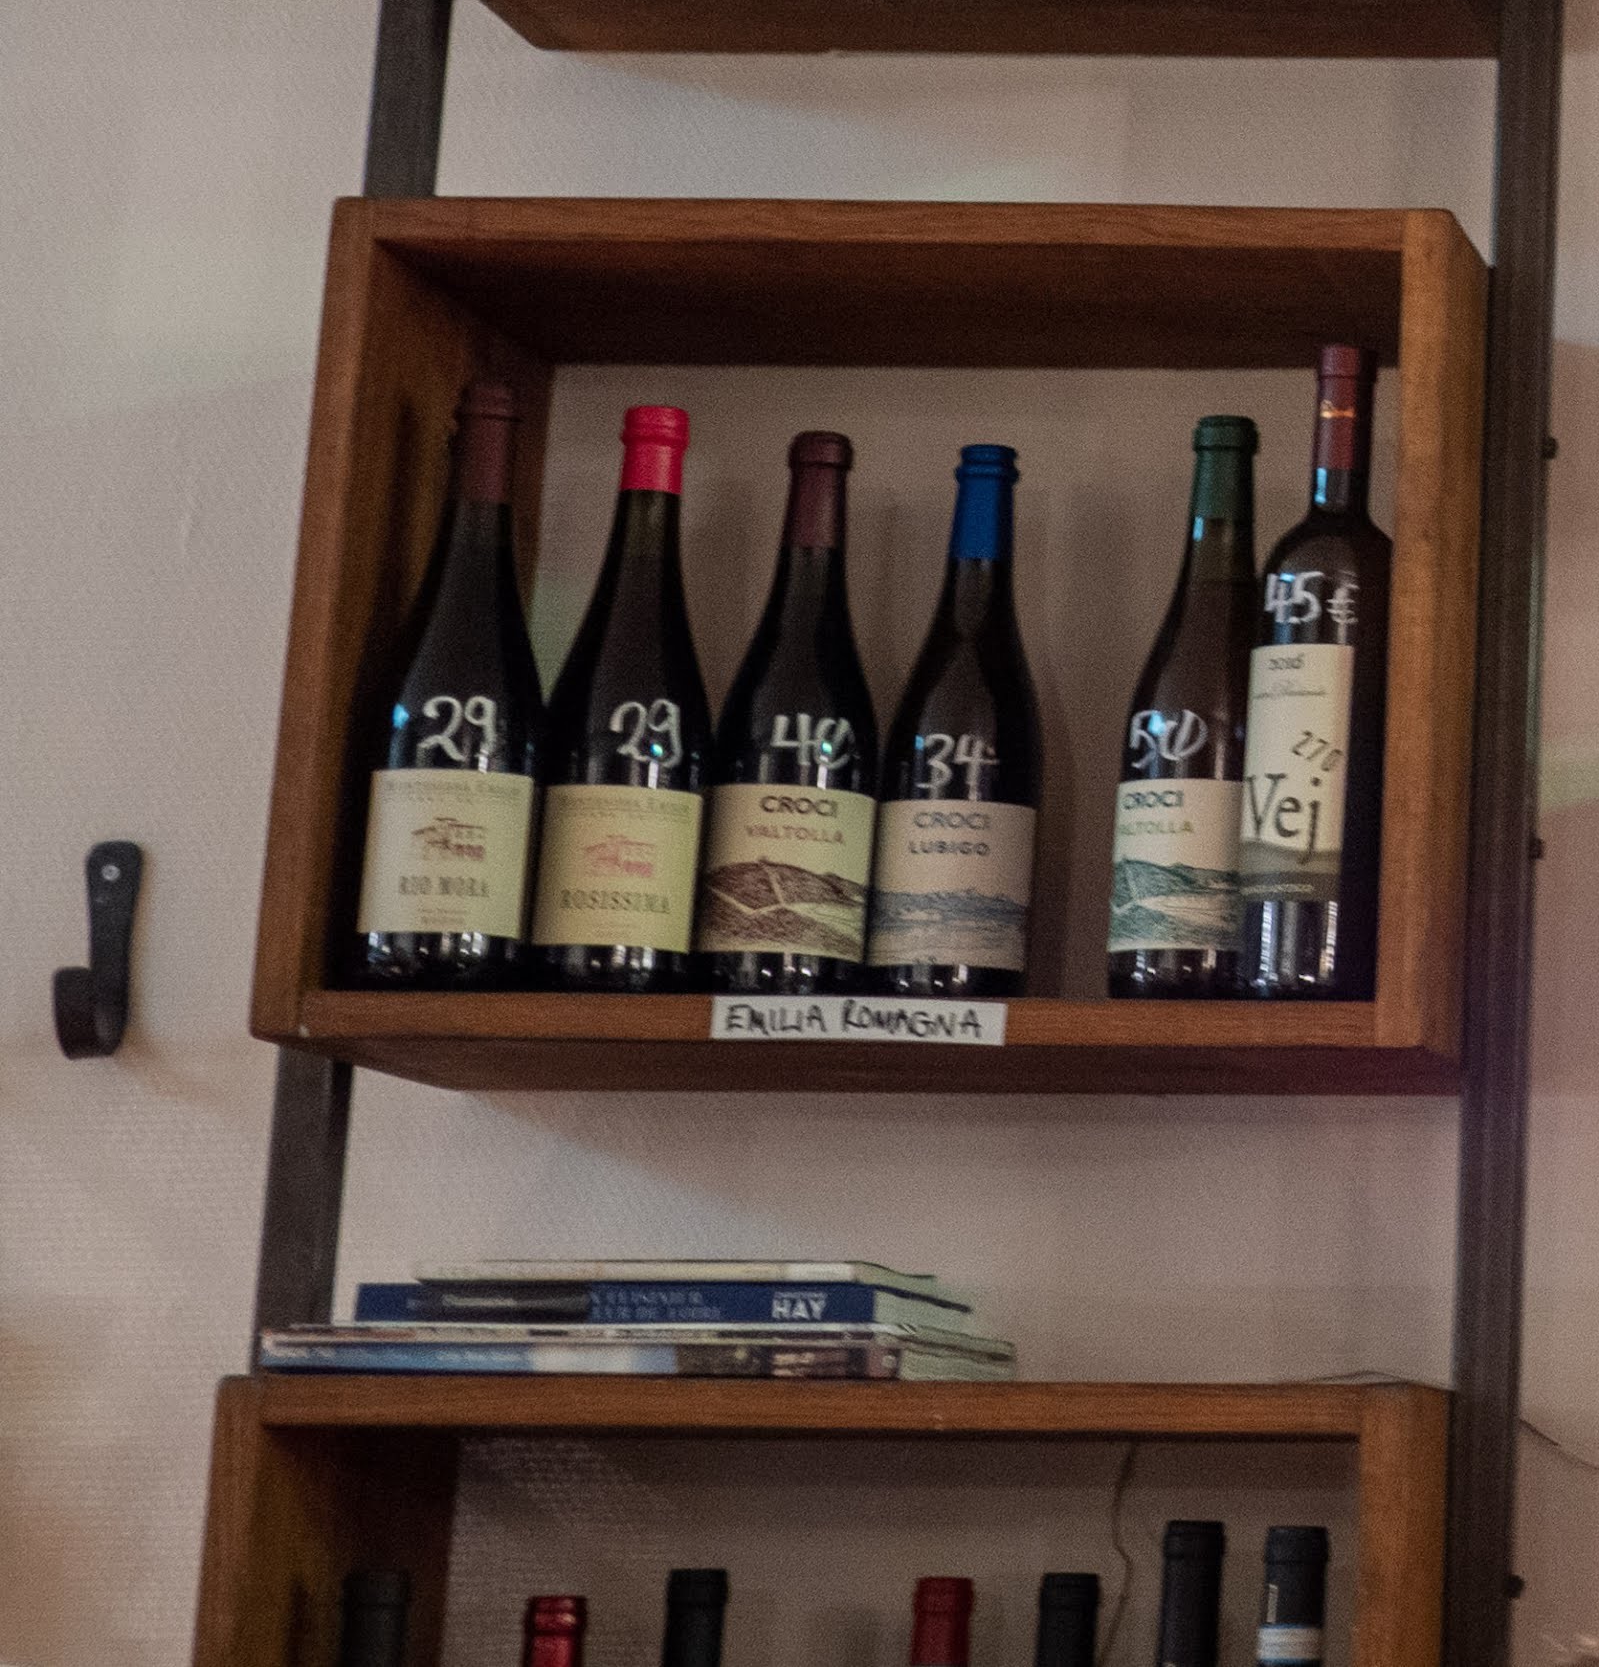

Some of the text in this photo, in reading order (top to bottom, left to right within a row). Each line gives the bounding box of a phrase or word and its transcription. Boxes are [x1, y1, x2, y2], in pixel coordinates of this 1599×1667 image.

[417, 694, 498, 763] 29
[609, 699, 682, 768] 29
[769, 712, 857, 770] 40
[1128, 709, 1209, 769] 50
[916, 734, 998, 790] 34
[760, 795, 839, 818] CROCI
[914, 811, 991, 832] CROCI
[1245, 771, 1322, 865] Vej
[725, 1000, 982, 1037] EMILIA ROMAGNA
[770, 1299, 829, 1323] HAY
